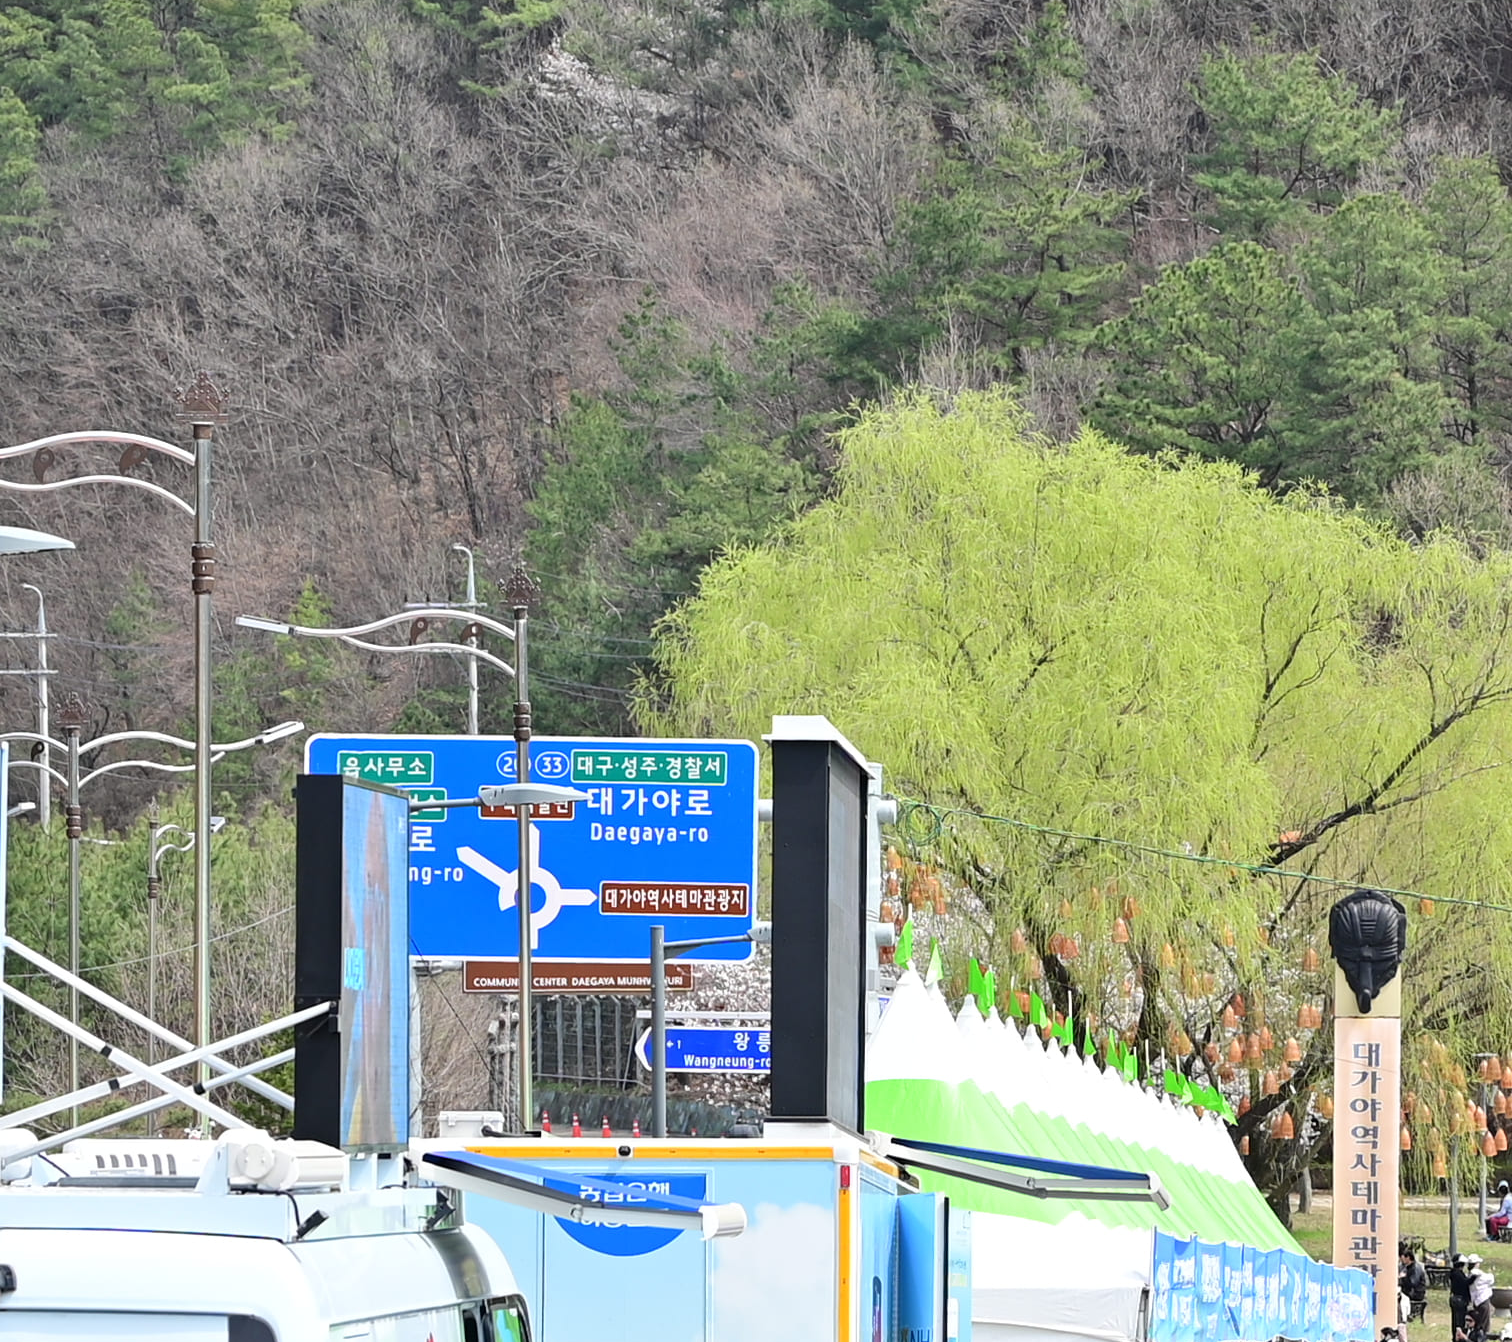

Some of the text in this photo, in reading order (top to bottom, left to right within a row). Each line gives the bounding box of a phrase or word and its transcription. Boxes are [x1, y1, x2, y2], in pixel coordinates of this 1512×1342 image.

[542, 756, 562, 773] 33
[587, 787, 712, 817] 대가야로
[590, 822, 709, 845] Daegaya-ro
[604, 888, 744, 911] 대가야역사테마관광지
[533, 977, 567, 987] CENTER
[571, 977, 615, 987] DAEGAYA
